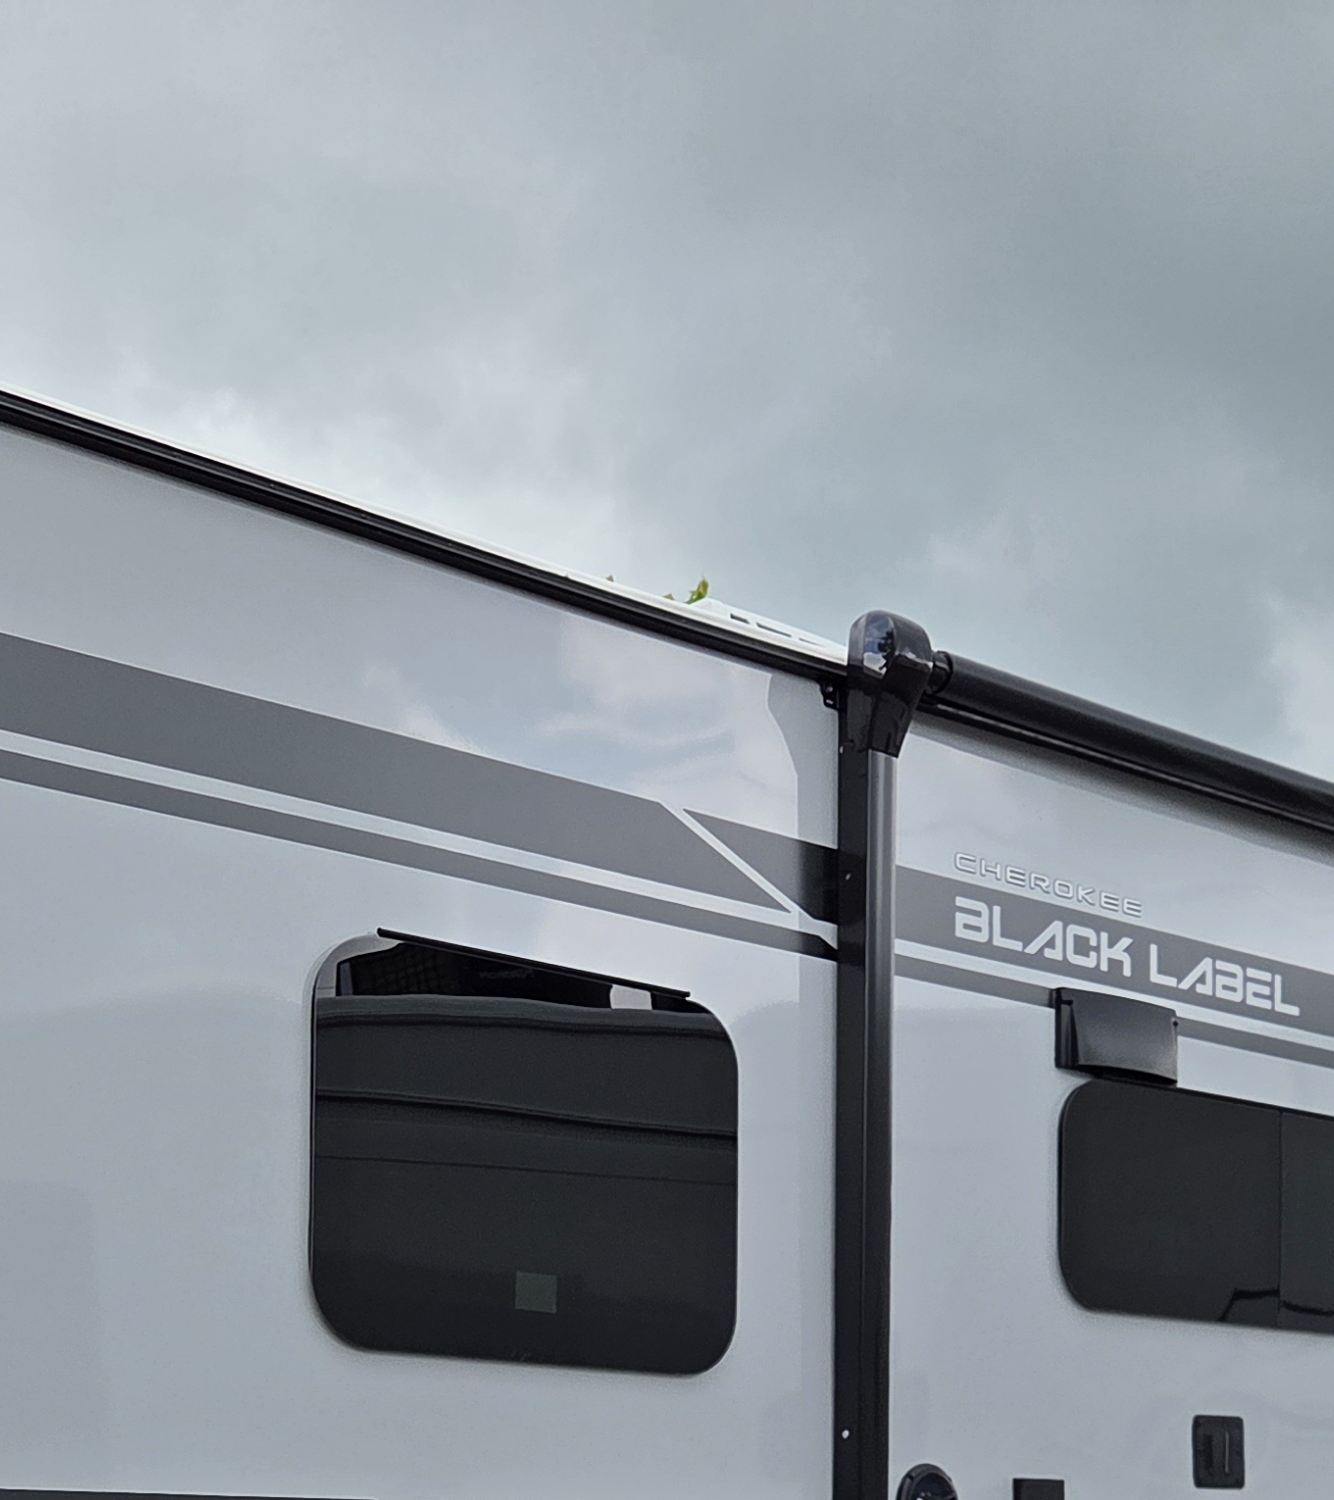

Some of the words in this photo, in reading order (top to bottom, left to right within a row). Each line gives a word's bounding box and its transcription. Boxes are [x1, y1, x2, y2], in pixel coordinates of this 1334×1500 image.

[954, 852, 1143, 918] CHEROKEE
[954, 896, 1134, 978] BLACK
[1149, 943, 1301, 1017] LABEL
